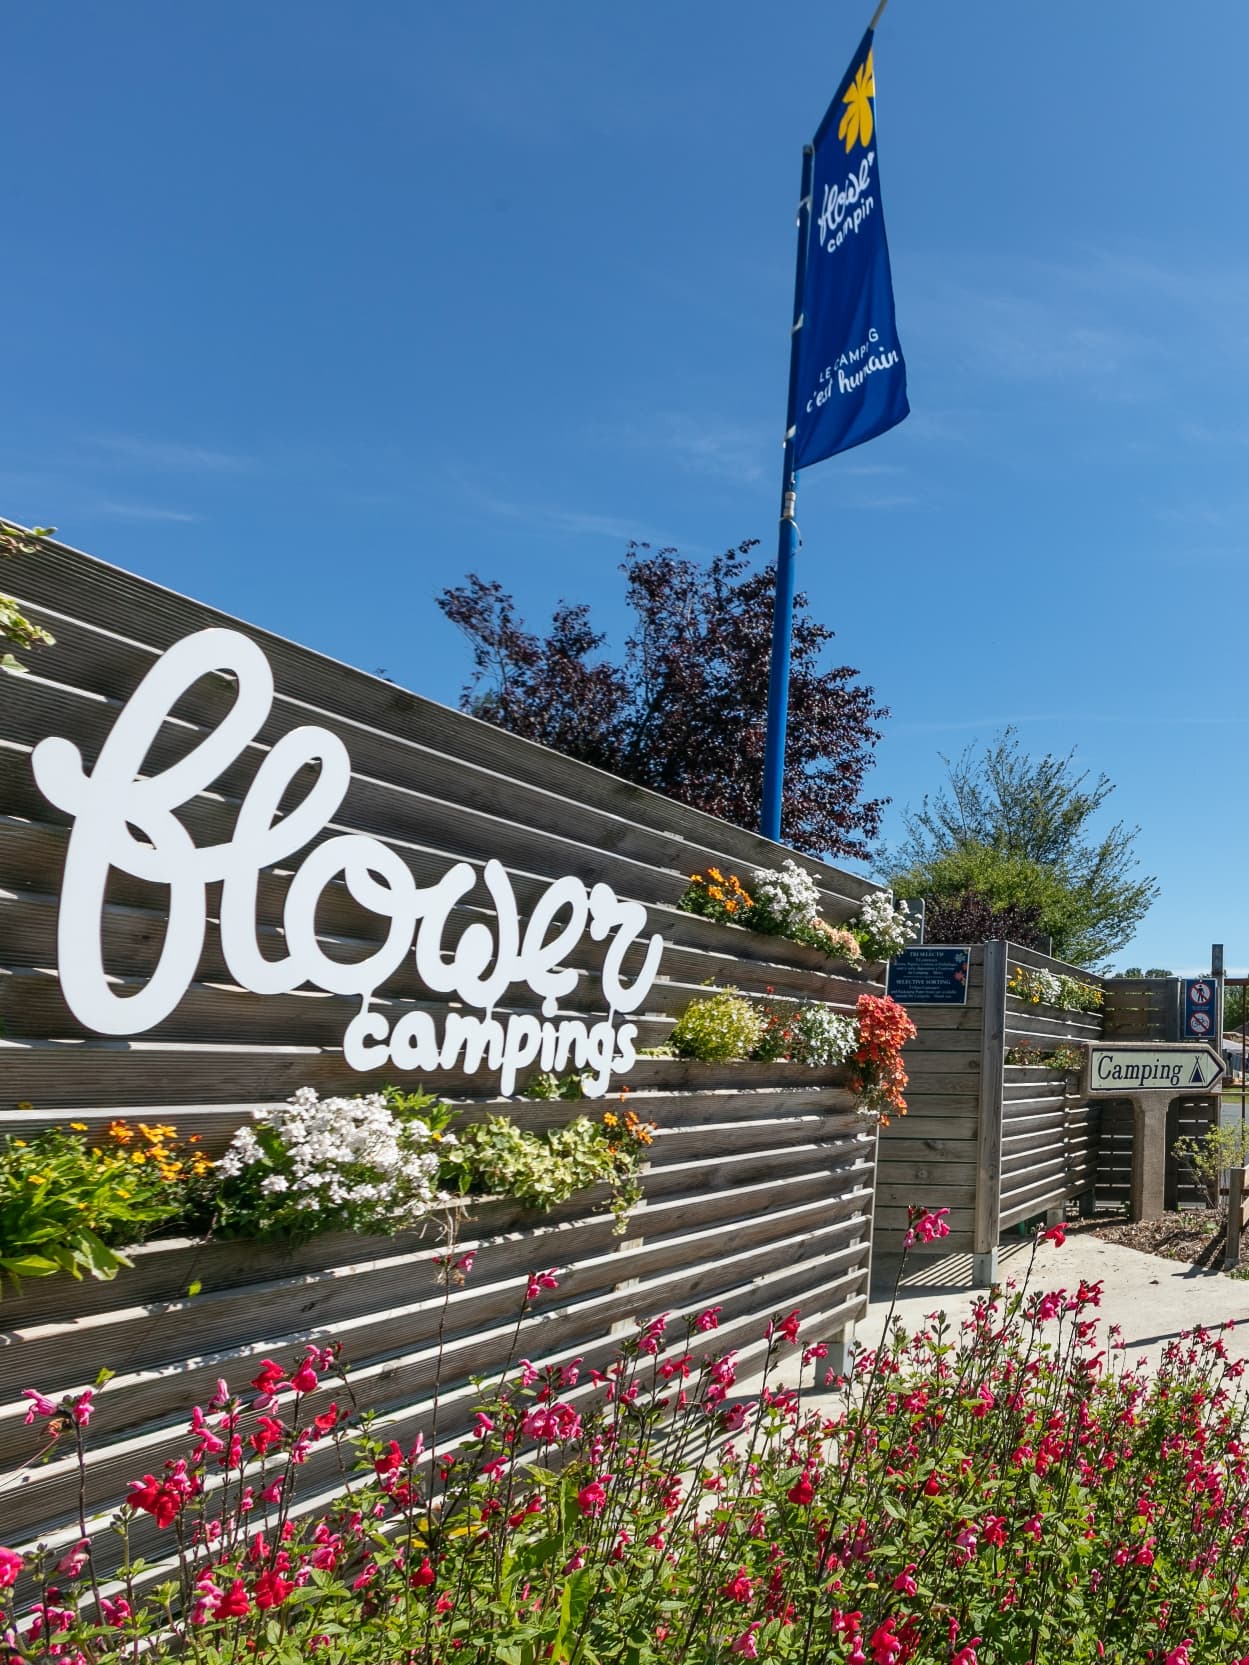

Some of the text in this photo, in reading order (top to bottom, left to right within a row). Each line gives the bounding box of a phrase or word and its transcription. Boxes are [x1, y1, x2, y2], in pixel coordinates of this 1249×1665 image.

[827, 196, 874, 253] campin
[819, 327, 879, 383] LE CAMPIG
[31, 628, 664, 1035] flower
[344, 1009, 638, 1098] campings
[1098, 1055, 1183, 1086] Camping
